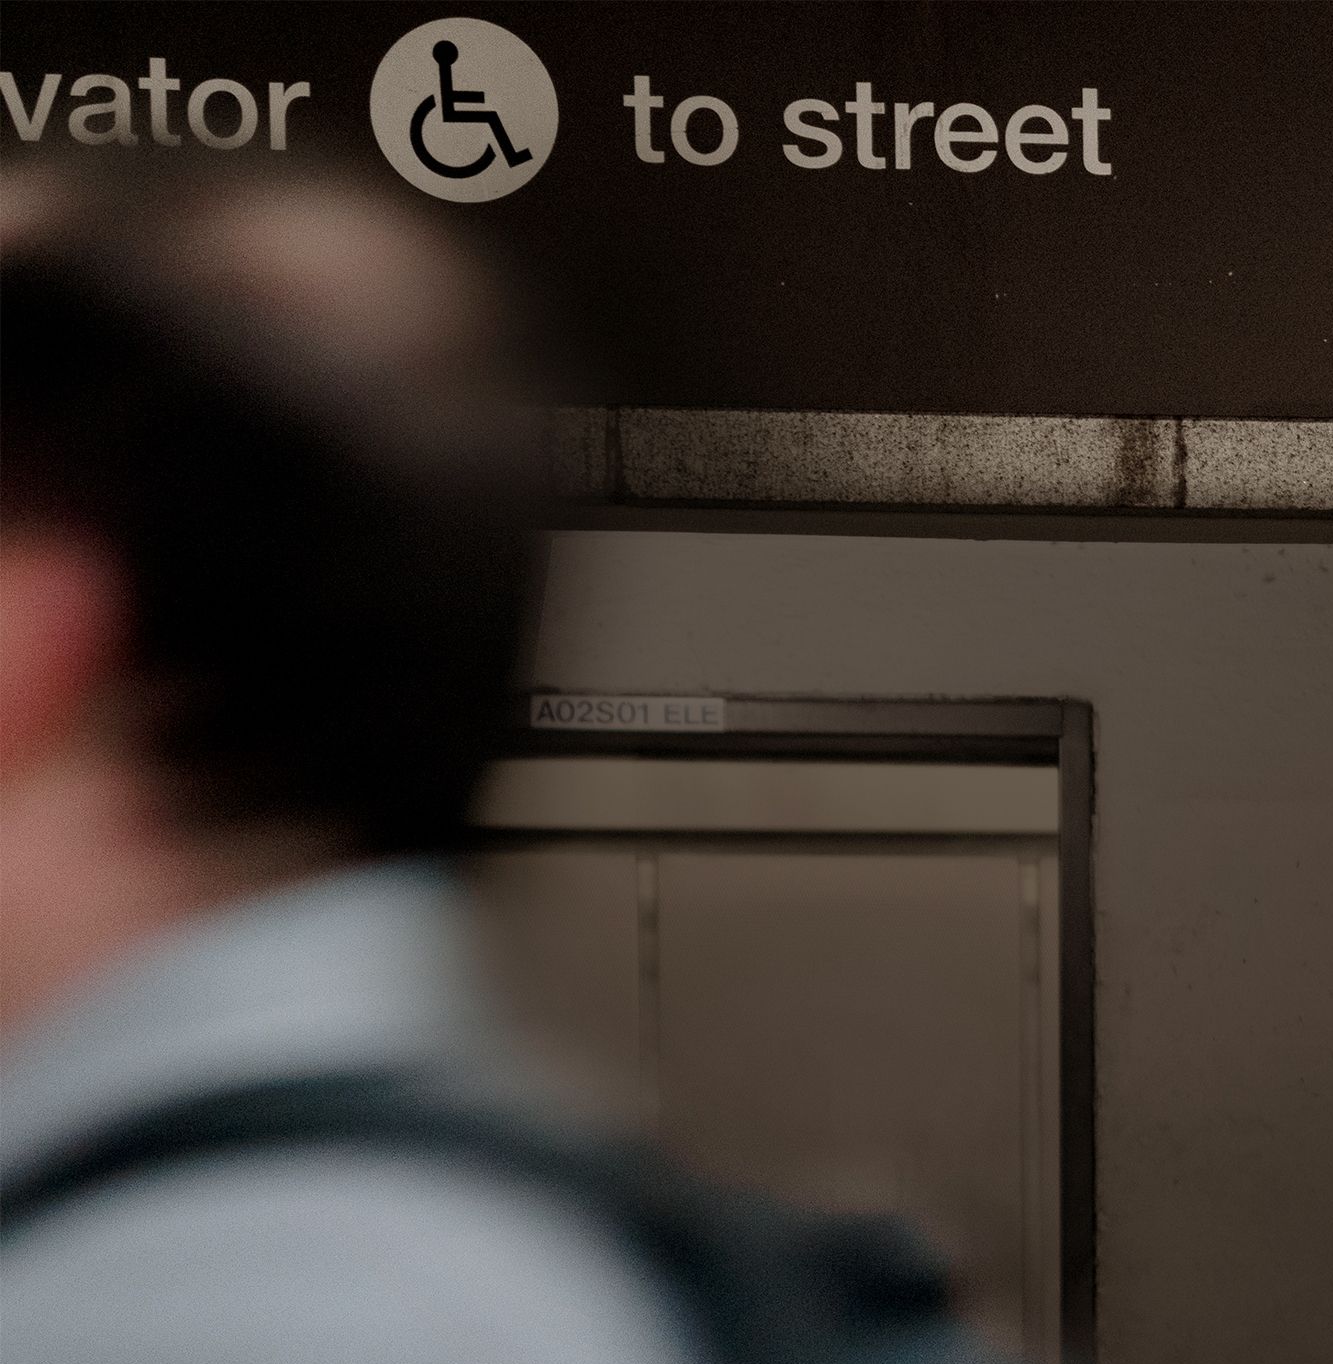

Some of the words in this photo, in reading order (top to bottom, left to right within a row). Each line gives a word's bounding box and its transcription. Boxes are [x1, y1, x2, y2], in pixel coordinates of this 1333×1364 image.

[0, 57, 311, 150] vator
[623, 75, 740, 167] to
[782, 82, 1113, 177] street
[663, 703, 719, 725] ELE
